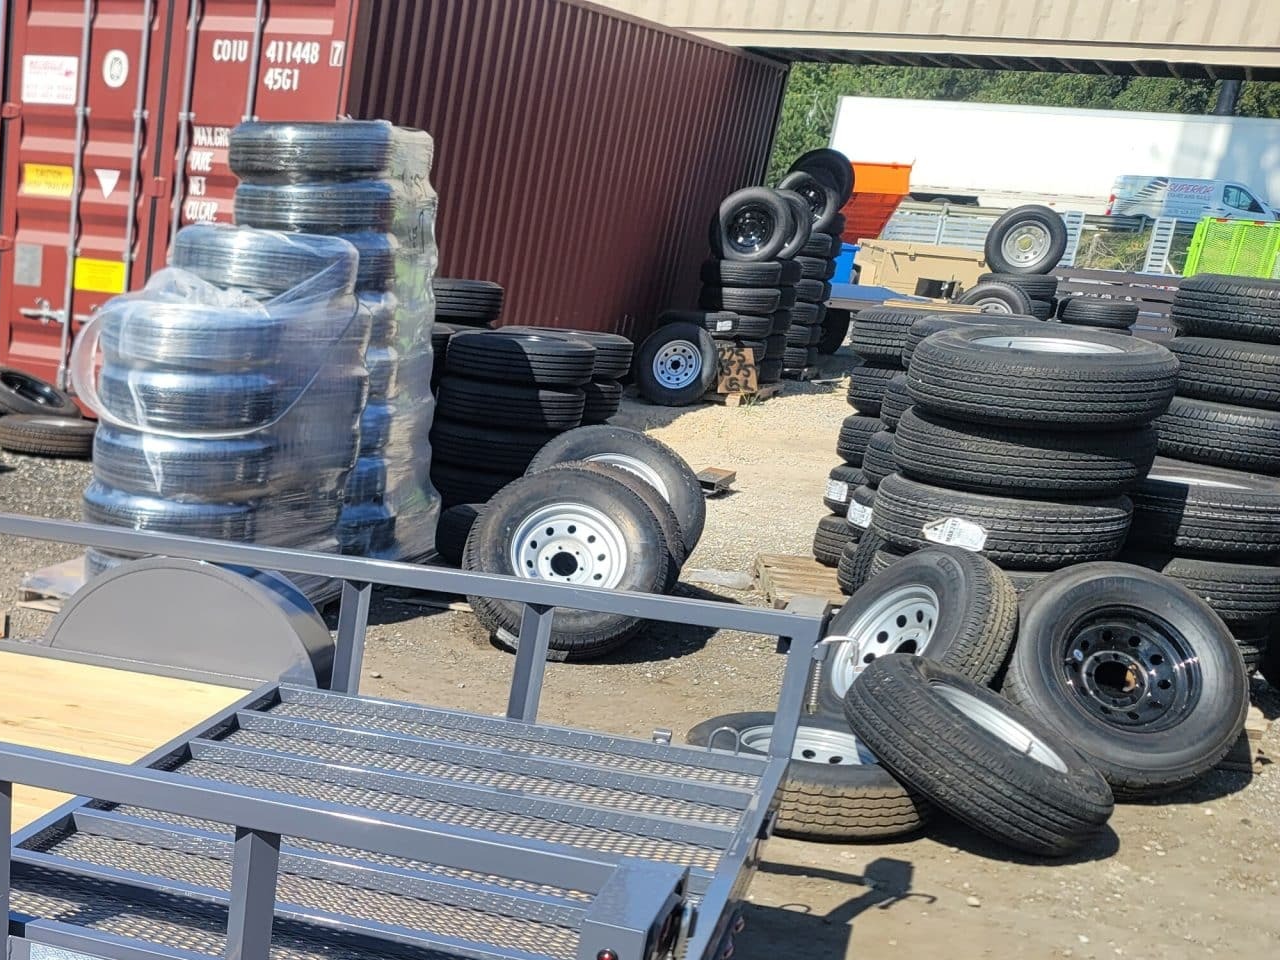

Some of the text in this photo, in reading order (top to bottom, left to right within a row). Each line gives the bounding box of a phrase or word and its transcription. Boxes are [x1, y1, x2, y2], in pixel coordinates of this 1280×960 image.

[212, 39, 248, 61] COIU
[265, 40, 320, 64] 411448
[264, 67, 299, 90] 45G1
[189, 176, 206, 196] NET
